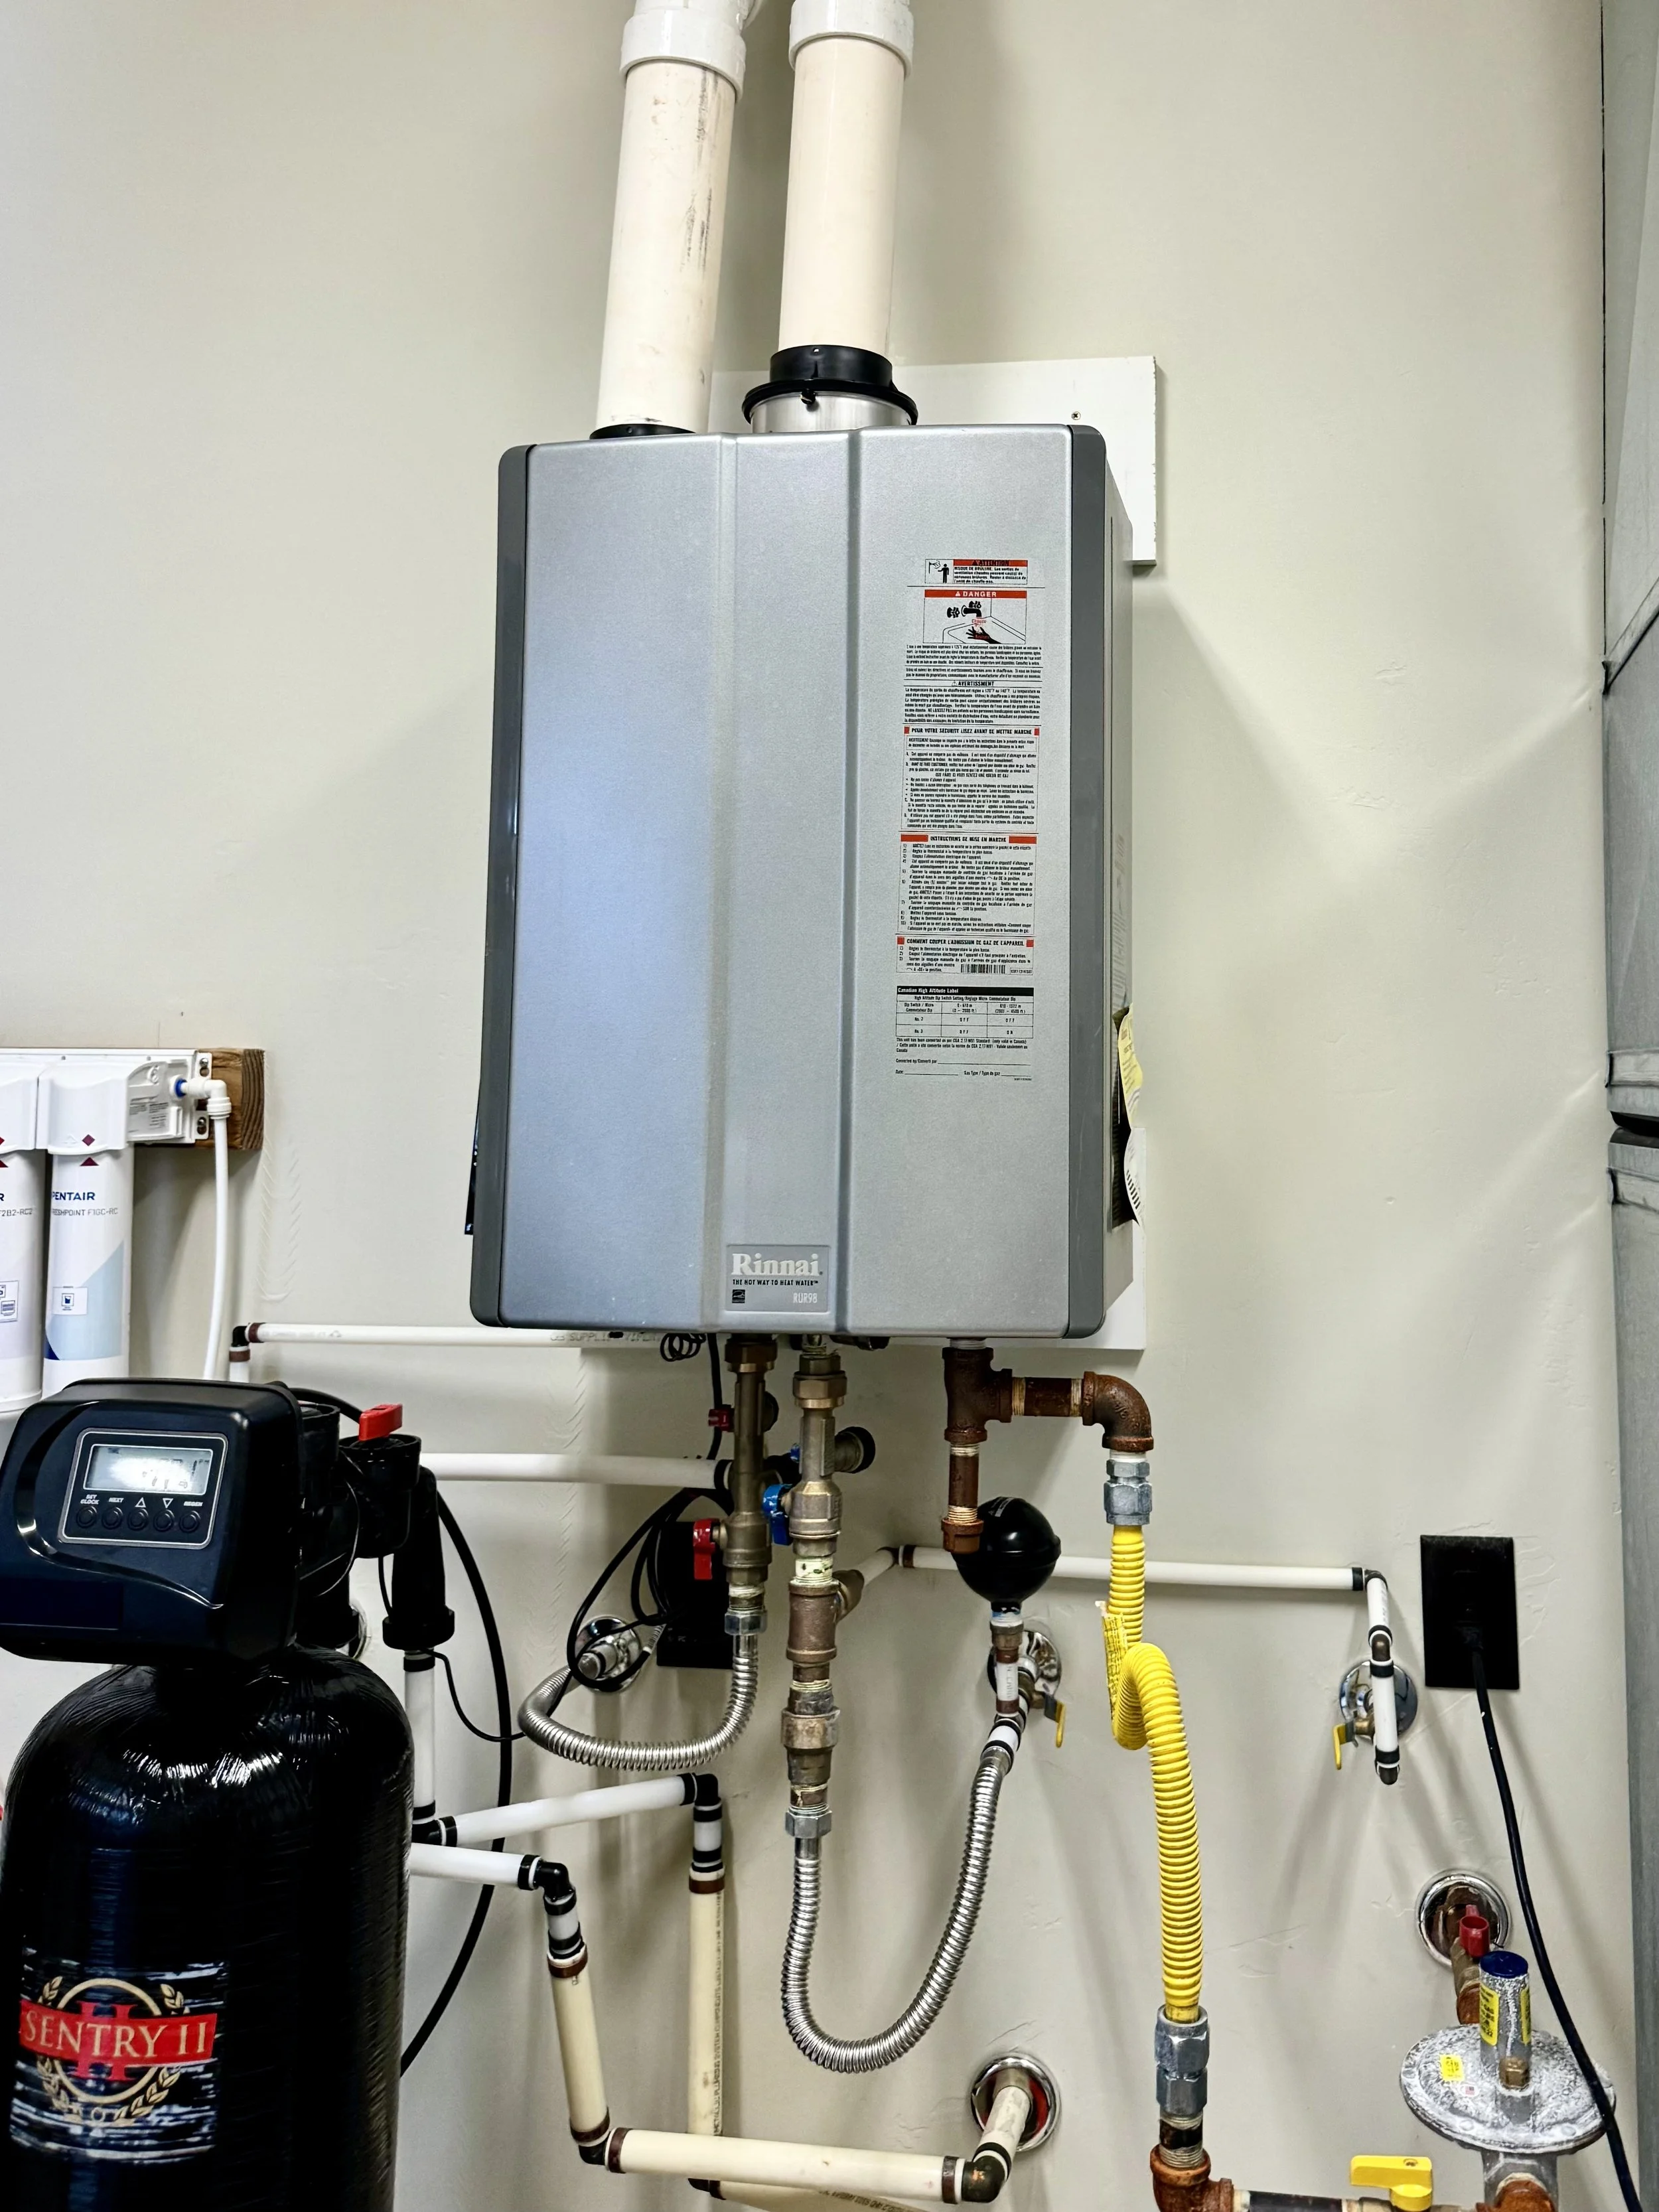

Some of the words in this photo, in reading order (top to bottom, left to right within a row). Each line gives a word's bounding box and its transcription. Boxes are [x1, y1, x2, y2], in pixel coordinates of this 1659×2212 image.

[731, 1252, 820, 1277] Rinnai
[793, 1293, 818, 1303] RUR98
[25, 2010, 169, 2058] SENTRY
[178, 2022, 208, 2055] II
